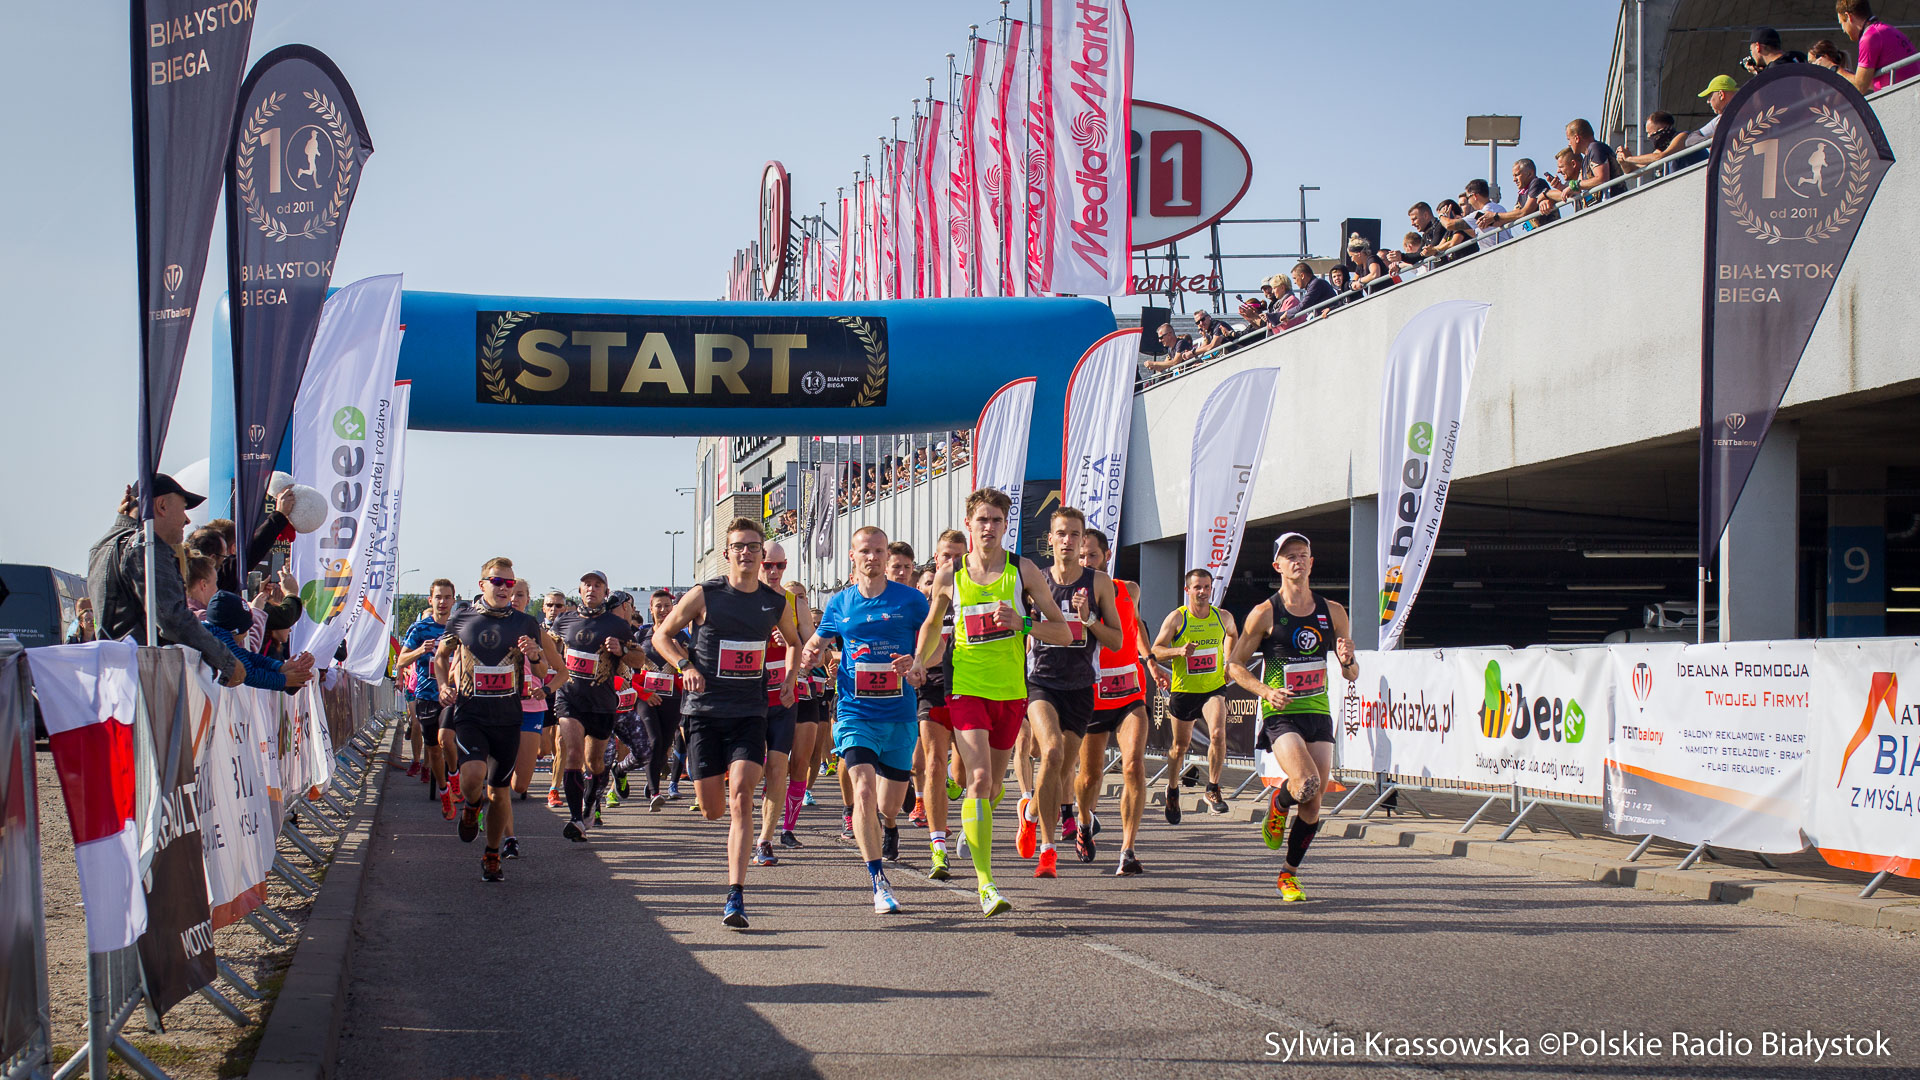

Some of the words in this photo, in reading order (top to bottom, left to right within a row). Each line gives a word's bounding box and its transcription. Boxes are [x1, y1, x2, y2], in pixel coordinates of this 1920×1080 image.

[150, 0, 254, 48] BIAŁYSTOK
[150, 49, 211, 85] BIEGA
[276, 203, 291, 214] od
[293, 201, 315, 214] 2011
[1770, 207, 1787, 219] od
[1790, 207, 1818, 219] 2011
[241, 260, 332, 283] BIAŁYSTOK
[1718, 263, 1834, 281] BIAŁYSTOK
[241, 287, 288, 307] BIEGA
[1718, 287, 1781, 303] BIEGA
[515, 329, 807, 394] START
[1441, 420, 1460, 474] rodziny
[367, 502, 380, 526] dla
[375, 399, 390, 455] rodziny
[1108, 453, 1122, 499] TOBIE
[1088, 454, 1108, 530] AŁA
[1844, 547, 1870, 583] 9
[574, 657, 586, 668] 70
[735, 652, 753, 664] 36
[1194, 656, 1213, 667] 240
[483, 674, 506, 685] 171
[869, 673, 887, 685] 25
[1112, 675, 1126, 686] 41
[1295, 673, 1320, 687] 244
[1226, 699, 1258, 715] MOTOZBY
[1684, 730, 1712, 739] BALONY
[1716, 731, 1765, 741] REKLAMOWE
[1685, 745, 1718, 755] NAMIOTY
[1722, 746, 1770, 758] STELAŻOWE
[1780, 750, 1804, 760] BRAM
[1873, 735, 1920, 777] BIA
[1707, 763, 1729, 772] FLAGI
[1732, 764, 1775, 775] REKLAMOWE
[1851, 787, 1862, 807] Z
[1864, 785, 1913, 817] MYŚLĄ
